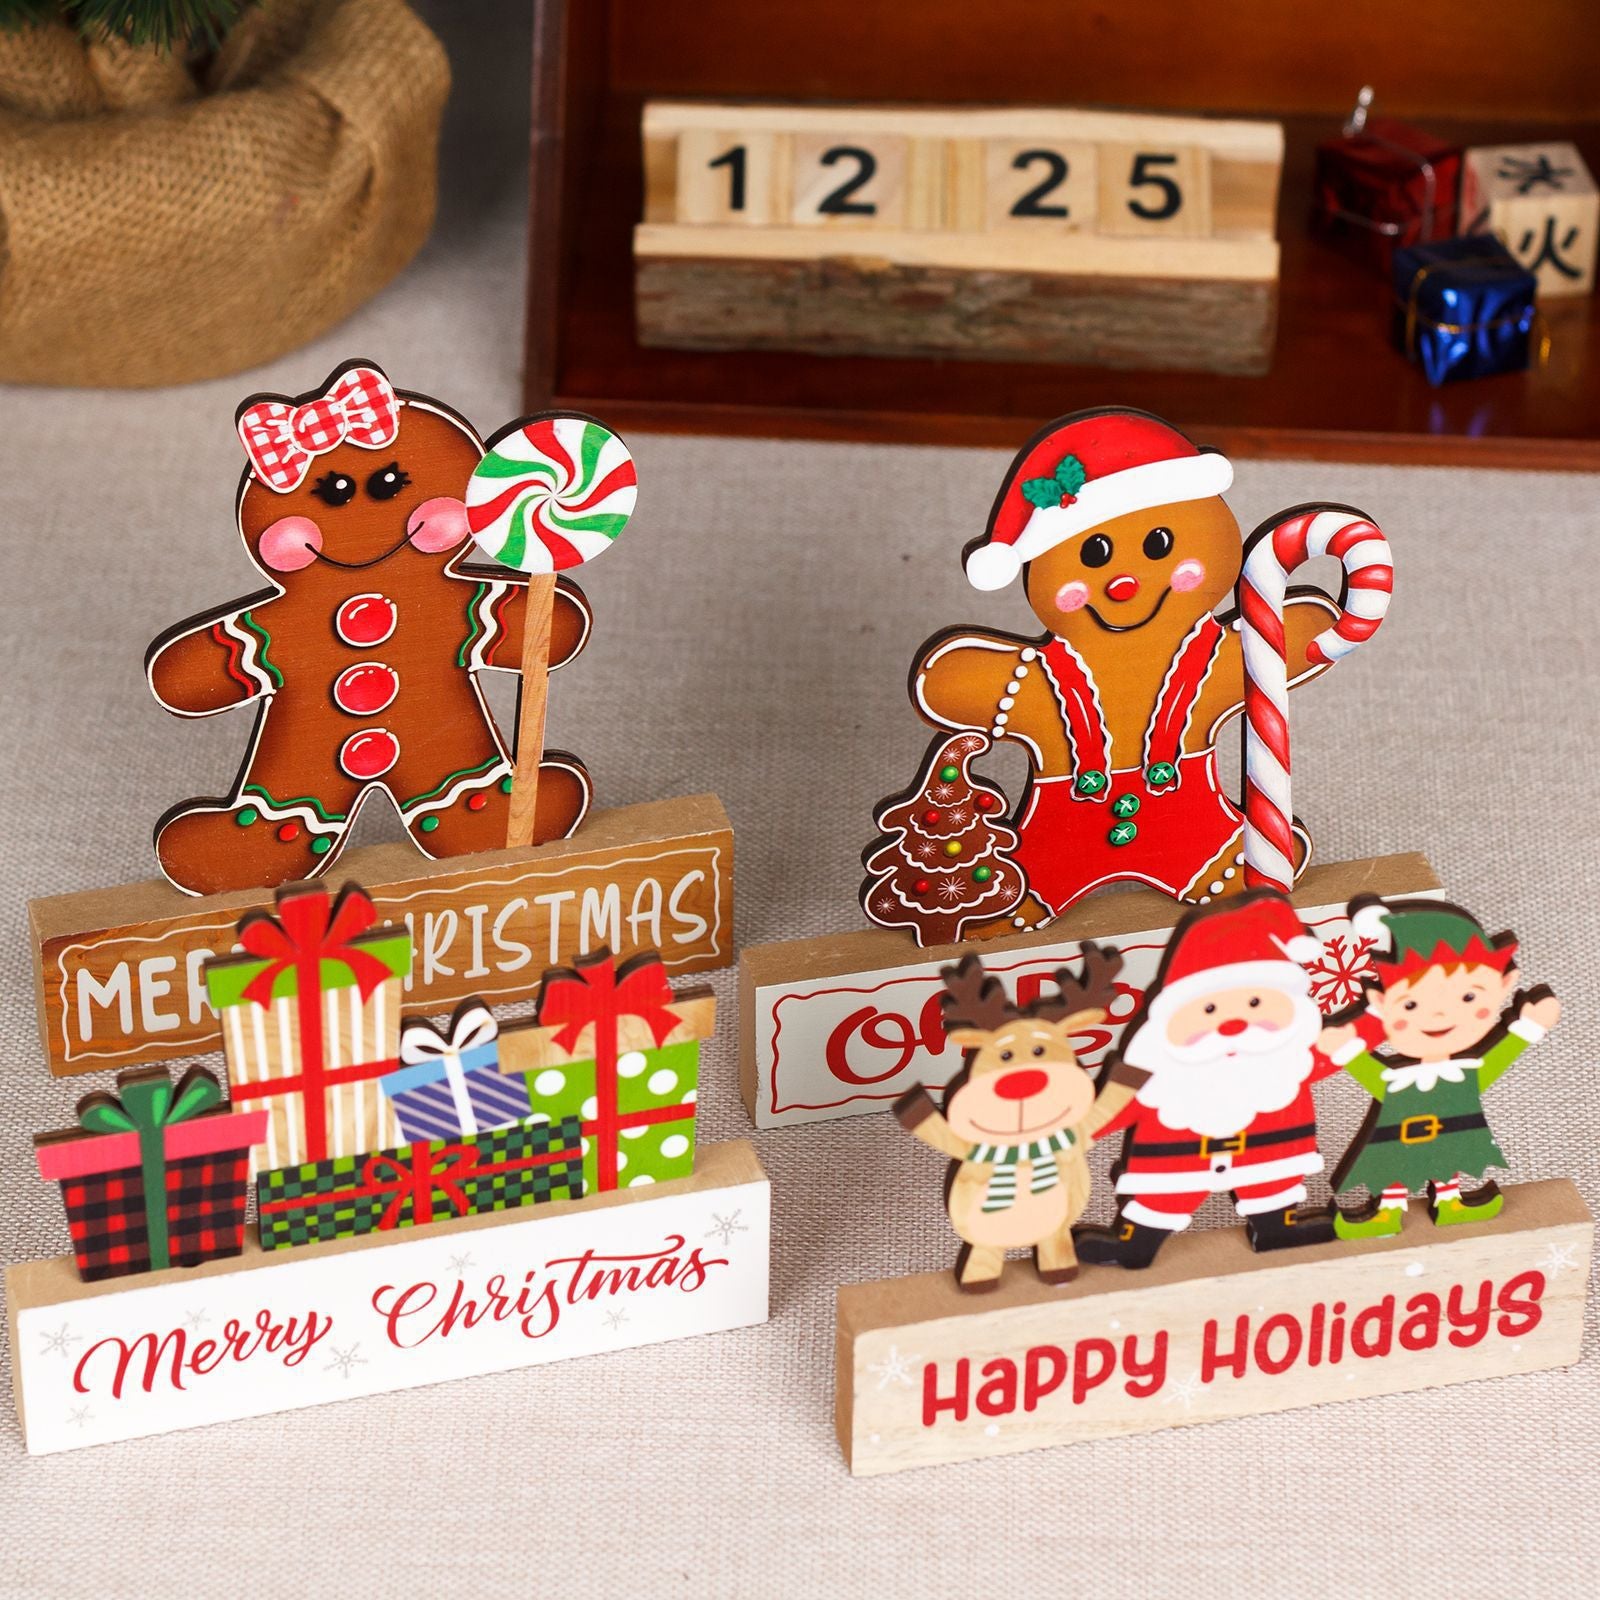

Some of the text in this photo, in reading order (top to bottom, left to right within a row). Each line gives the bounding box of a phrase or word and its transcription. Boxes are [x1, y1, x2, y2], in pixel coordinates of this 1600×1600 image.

[1519, 215, 1584, 280] 火
[76, 941, 246, 1042] MER
[73, 1233, 729, 1399] Merry Christmas
[921, 1269, 1546, 1428] Happy Holidays
